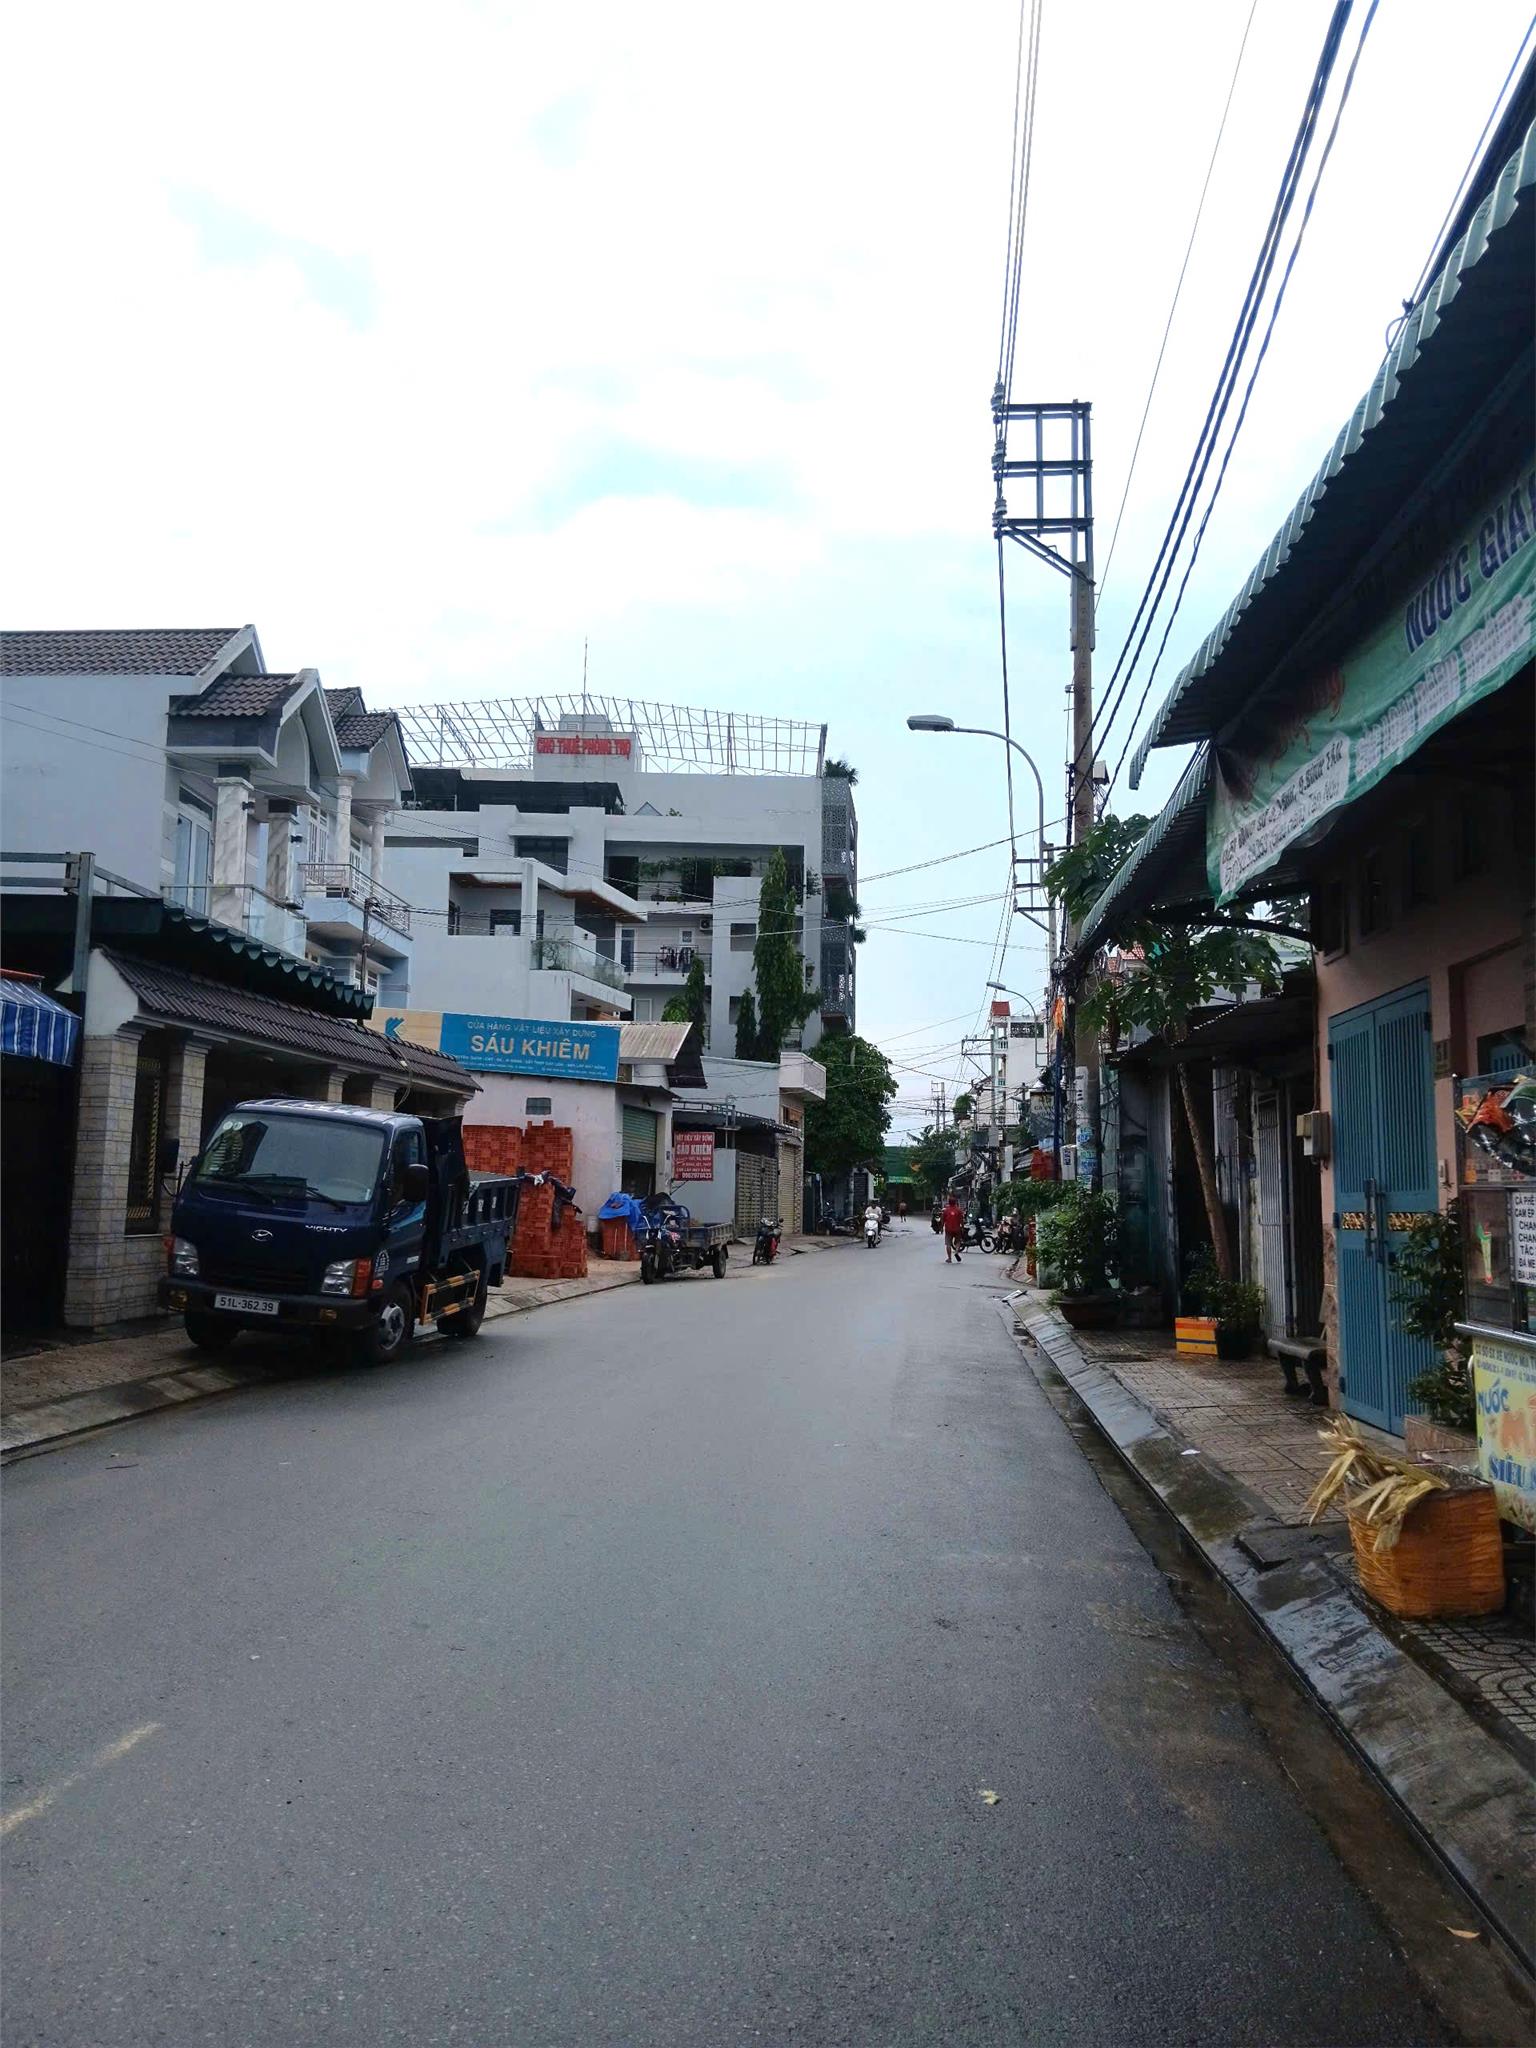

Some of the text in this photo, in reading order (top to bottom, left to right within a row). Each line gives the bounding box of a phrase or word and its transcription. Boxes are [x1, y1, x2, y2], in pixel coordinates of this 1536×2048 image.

[471, 1033, 591, 1061] SÁU KHIÊM
[220, 1296, 274, 1312] 51L-362.39
